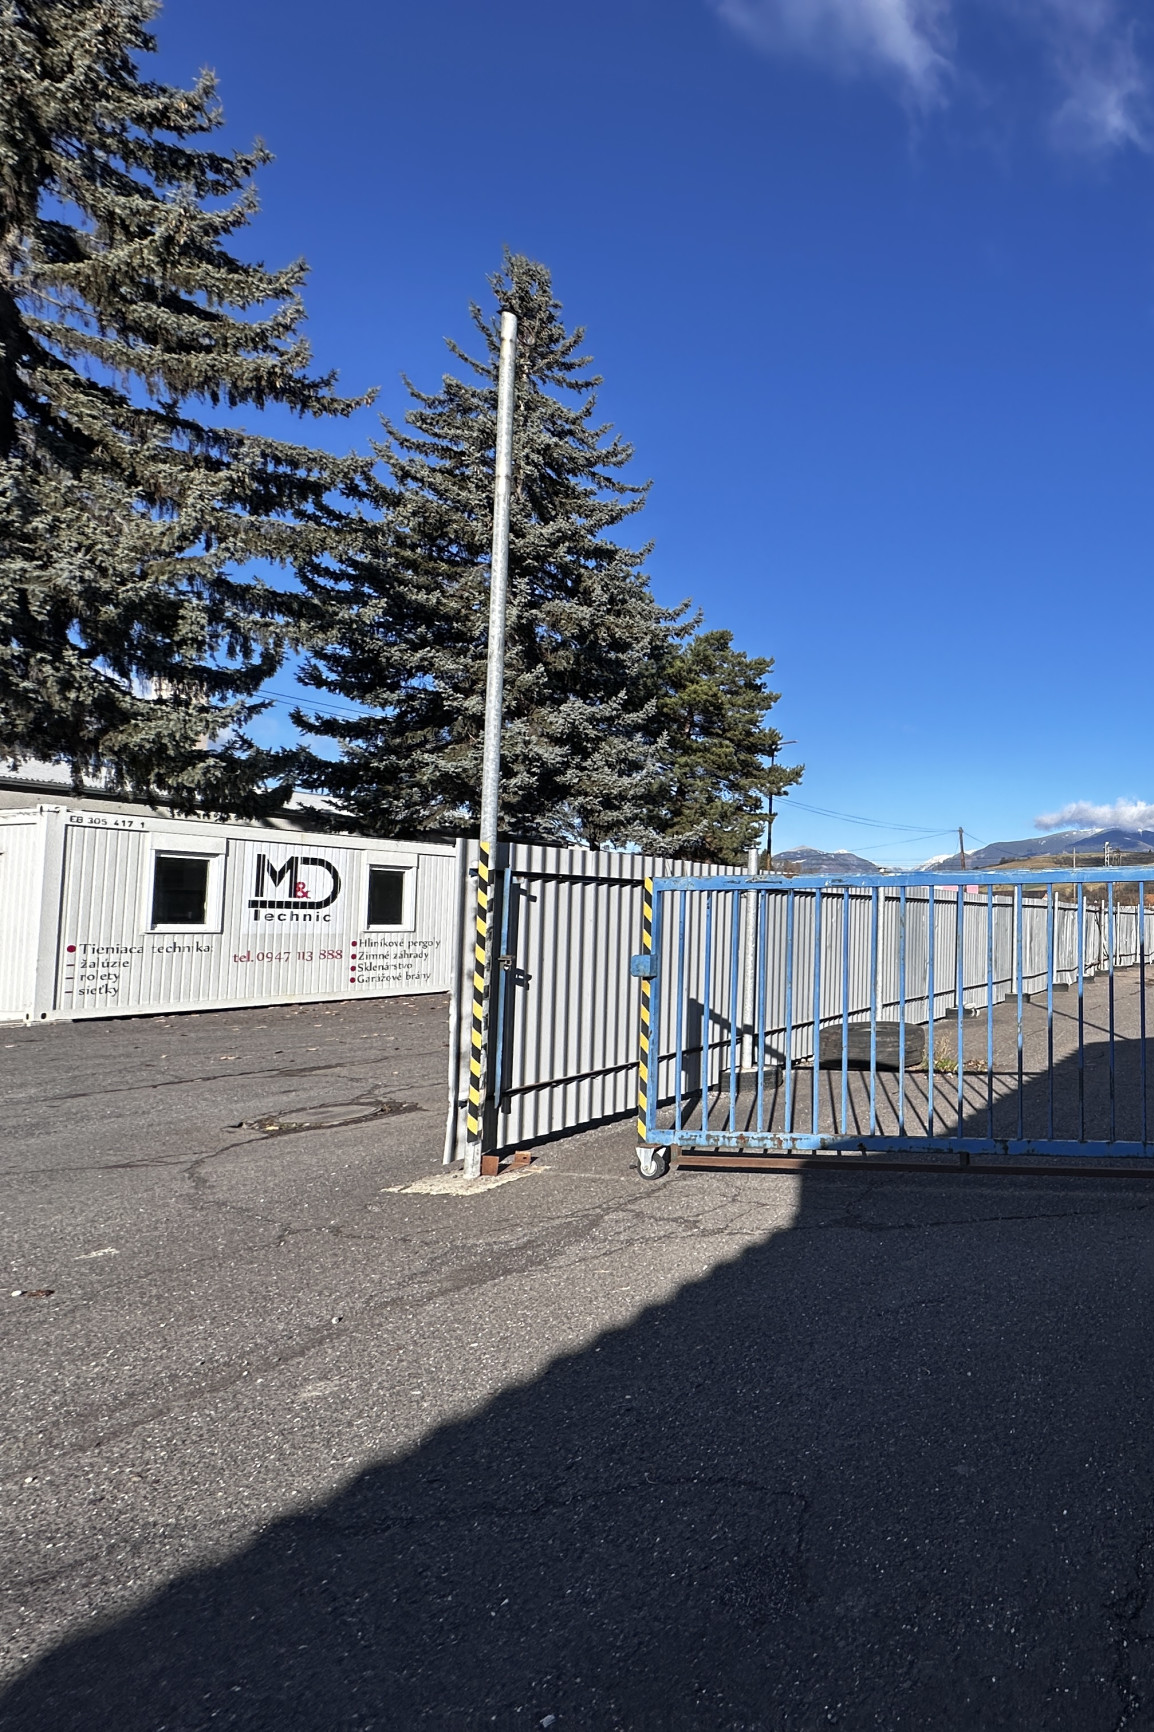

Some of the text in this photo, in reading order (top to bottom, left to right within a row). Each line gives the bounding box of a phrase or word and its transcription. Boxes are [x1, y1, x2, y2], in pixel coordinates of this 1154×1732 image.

[88, 817, 107, 825] 305
[248, 854, 341, 909] M&D
[254, 909, 331, 922] Technic
[79, 943, 144, 955] Tieniaca
[408, 937, 441, 950] pergoly
[297, 951, 313, 961] 113
[319, 950, 343, 960] 888
[358, 950, 429, 961] Zimné záhrady
[80, 957, 129, 969] žalúzie
[80, 970, 119, 983] rolety
